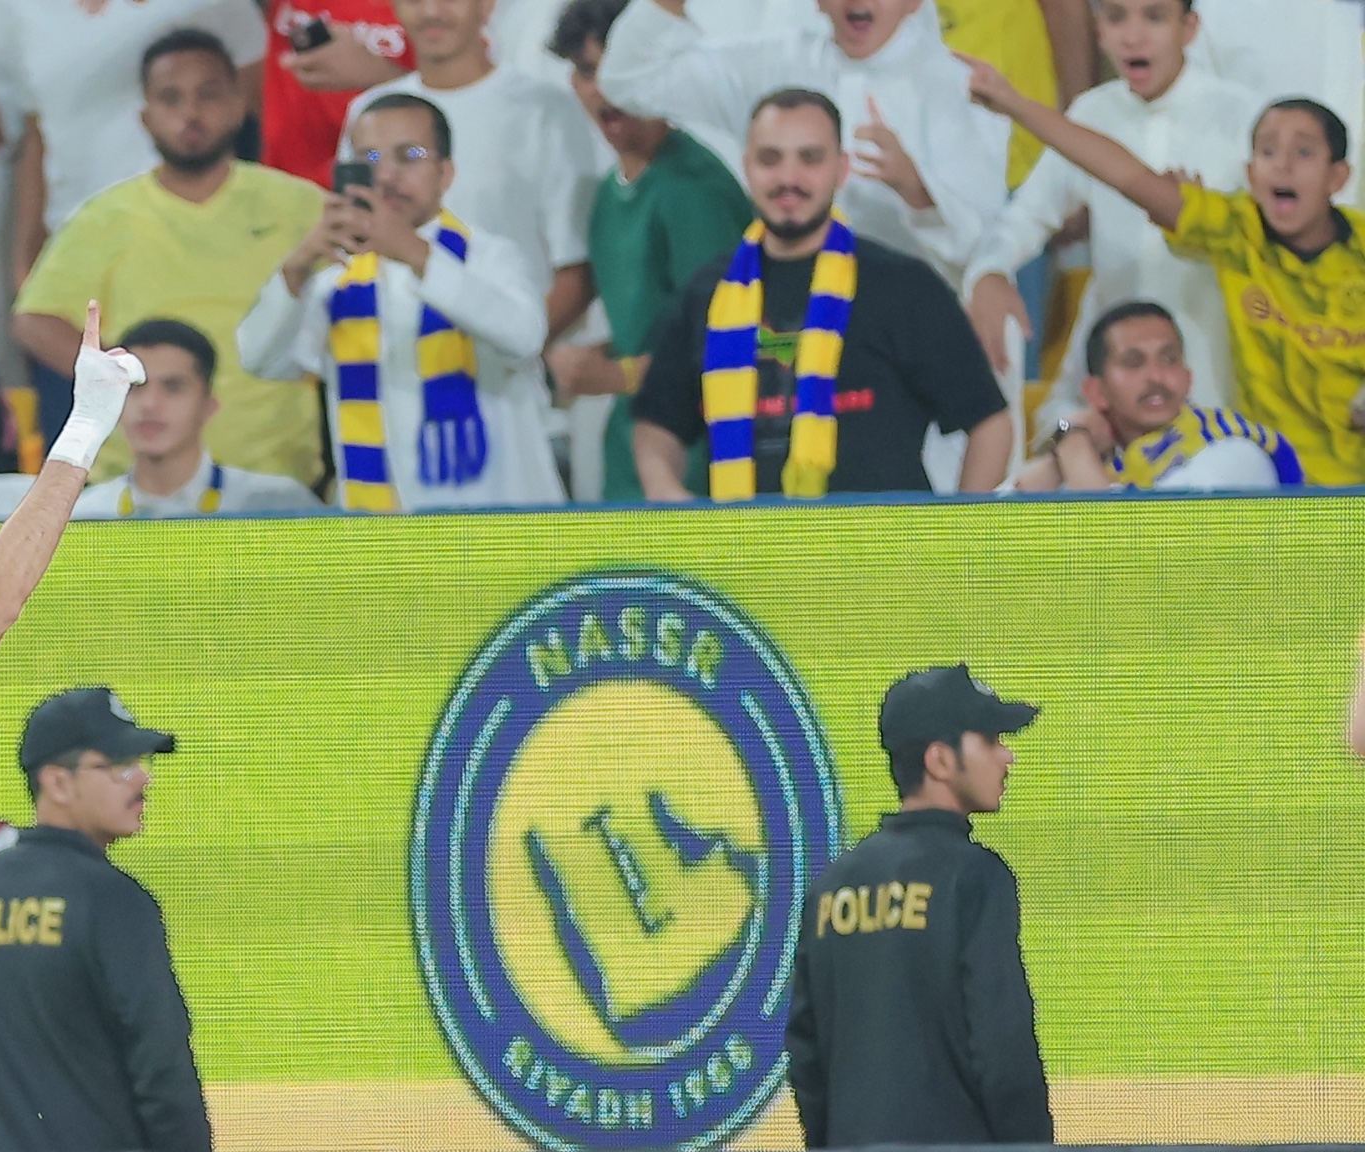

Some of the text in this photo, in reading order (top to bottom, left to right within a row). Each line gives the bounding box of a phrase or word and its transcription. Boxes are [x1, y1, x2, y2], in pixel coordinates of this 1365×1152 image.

[525, 605, 724, 692] NASSR
[816, 880, 934, 940] POLICE
[502, 1034, 654, 1131] RIYADH
